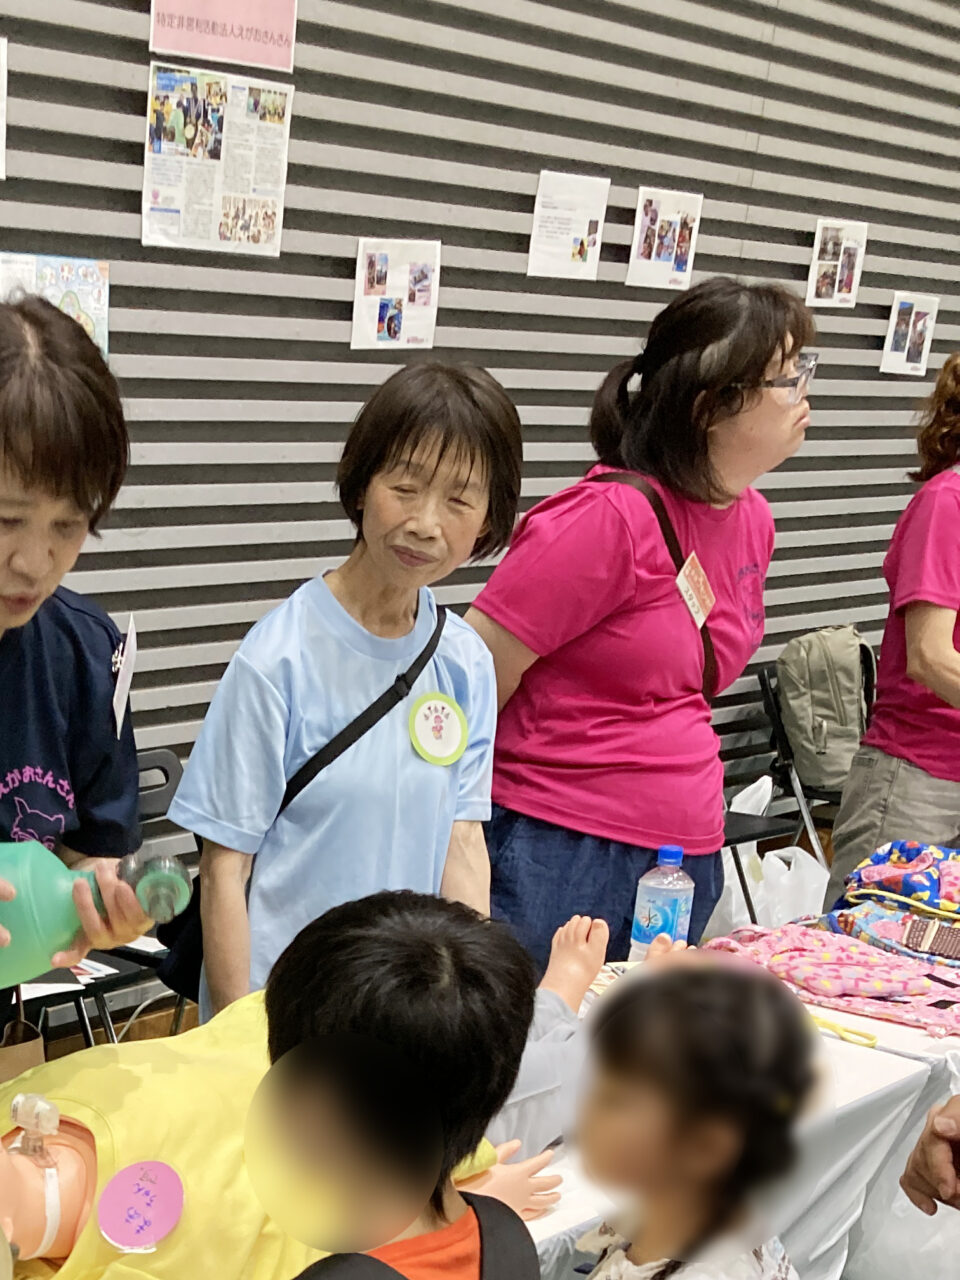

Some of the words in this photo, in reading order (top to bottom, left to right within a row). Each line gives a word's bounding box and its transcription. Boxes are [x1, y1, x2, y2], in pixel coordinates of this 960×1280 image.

[156, 12, 291, 48] 特定非営利活動法人えがおさんさん
